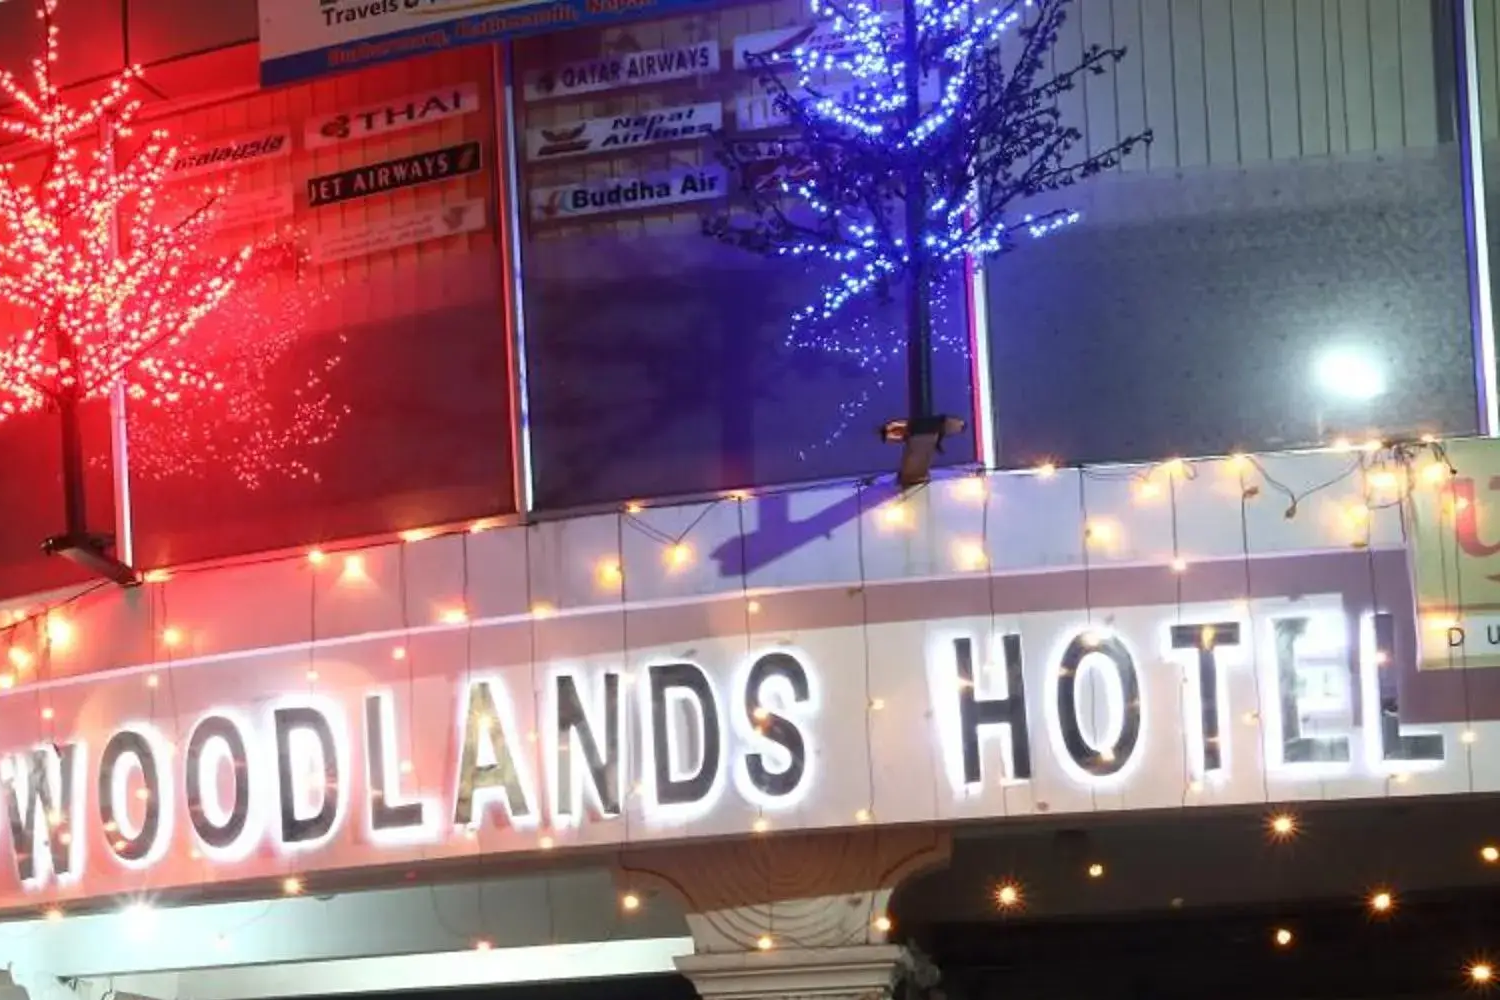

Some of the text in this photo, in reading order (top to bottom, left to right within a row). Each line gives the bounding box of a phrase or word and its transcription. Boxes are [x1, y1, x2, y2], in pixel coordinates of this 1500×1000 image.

[322, 0, 398, 26] Travels
[562, 47, 709, 88] QATAR AIRWAYS
[355, 91, 461, 129] THAI
[612, 108, 694, 131] Nepal
[601, 123, 713, 147] Airlines
[310, 153, 449, 201] JET AIRWAYS
[572, 172, 719, 208] Buddha Air
[2, 612, 1444, 881] WOODLANDS HOTEL
